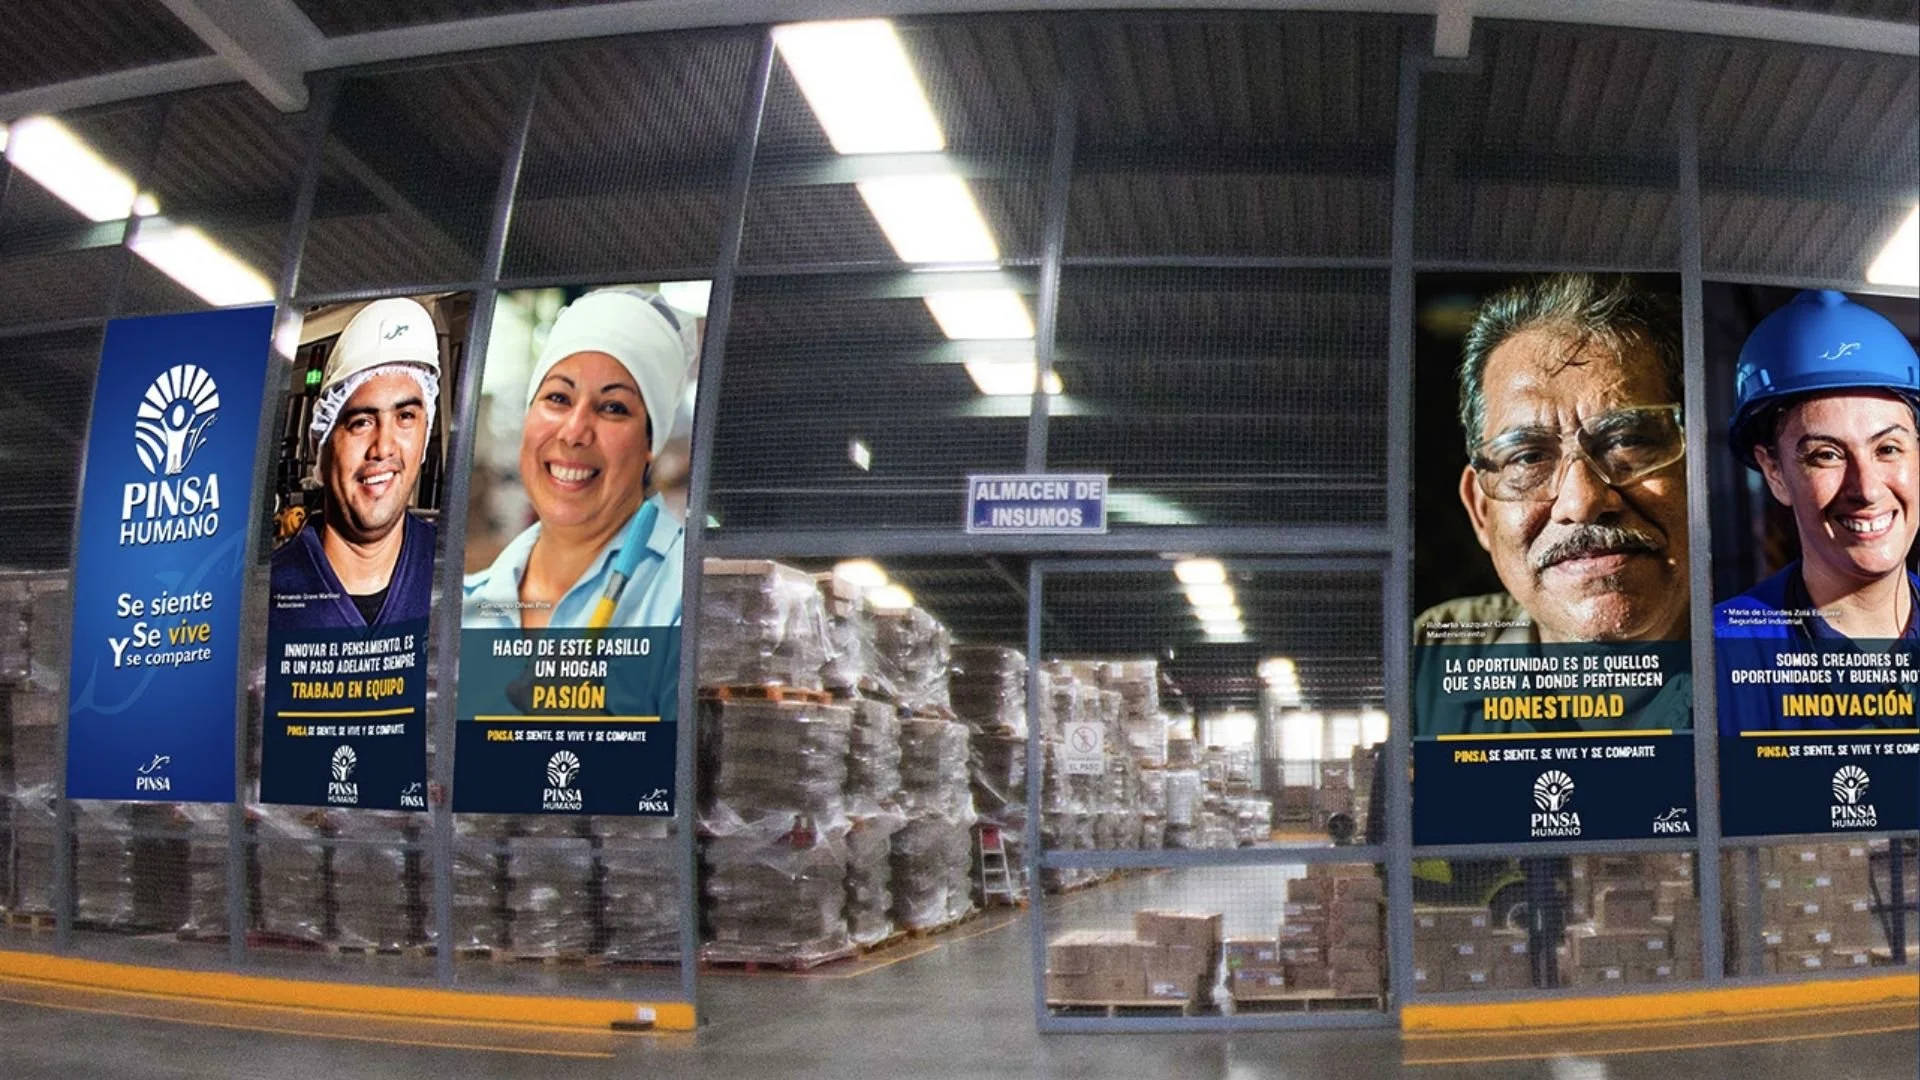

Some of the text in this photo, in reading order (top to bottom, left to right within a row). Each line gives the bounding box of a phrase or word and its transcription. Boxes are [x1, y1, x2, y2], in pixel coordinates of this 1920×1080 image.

[121, 473, 220, 520] PINSA
[976, 482, 1101, 500] ALMACEN DE
[992, 508, 1083, 526] INSUMOS
[119, 513, 219, 545] HUMANO
[117, 590, 212, 617] Se siente
[1752, 608, 1760, 616] de
[1762, 608, 1792, 616] Lourdes
[1728, 618, 1767, 626] Seguridad
[132, 619, 211, 647] Se vive
[108, 637, 211, 667] Y se comparte
[285, 635, 414, 658] INNOVAR EL PENSAMIENTO, ES
[493, 638, 650, 656] HAGO DE ESTE PASILLO
[281, 653, 416, 675] IR UN PASO ADELANTE SIEMPRE
[1445, 655, 1659, 673] LA OPORTUNIDAD ES DE QUELLOS
[1776, 653, 1910, 667] SOMOS CREADORES DE
[535, 660, 607, 677] UN HOGAR
[1443, 672, 1663, 693] QUE SABEN A DONDE PERTENECEN
[1732, 670, 1920, 684] OPORTUNIDADES Y BUENAS NO
[291, 677, 404, 700] TRABAJO EN EQUIPO
[532, 681, 606, 709] PASIÓN
[1483, 694, 1625, 720] HONESTIDAD
[1782, 689, 1913, 717] INNOVACIÓN
[376, 724, 404, 735] COMPARTE
[515, 730, 524, 741] SE
[555, 730, 565, 741] SE
[567, 730, 585, 742] VIVE
[588, 731, 594, 741] Y
[595, 730, 604, 741] SE
[606, 730, 646, 742] COMPARTE
[1489, 750, 1500, 761] SE
[1540, 748, 1552, 760] SE
[1555, 747, 1578, 760] VIVE
[1581, 747, 1588, 759] Y
[1591, 747, 1603, 758] SE
[1606, 746, 1655, 758] COMPARTE
[1790, 745, 1800, 757] SE
[1838, 744, 1848, 755] SE
[1851, 744, 1872, 755] VIVE
[1874, 744, 1881, 755] Y
[1884, 743, 1894, 755] SE
[136, 776, 170, 791] PINSA
[328, 782, 358, 796] PINSA
[328, 795, 358, 804] HUMANO
[400, 795, 424, 807] PINSA
[543, 788, 583, 802] PINSA
[543, 801, 582, 810] HUMANO
[638, 801, 669, 812] PINSA
[1831, 804, 1877, 818] PINSA
[1531, 812, 1580, 828] PINSA
[1653, 821, 1690, 833] PINSA
[1832, 818, 1877, 828] HUMANO
[1531, 827, 1581, 837] HUMANO
